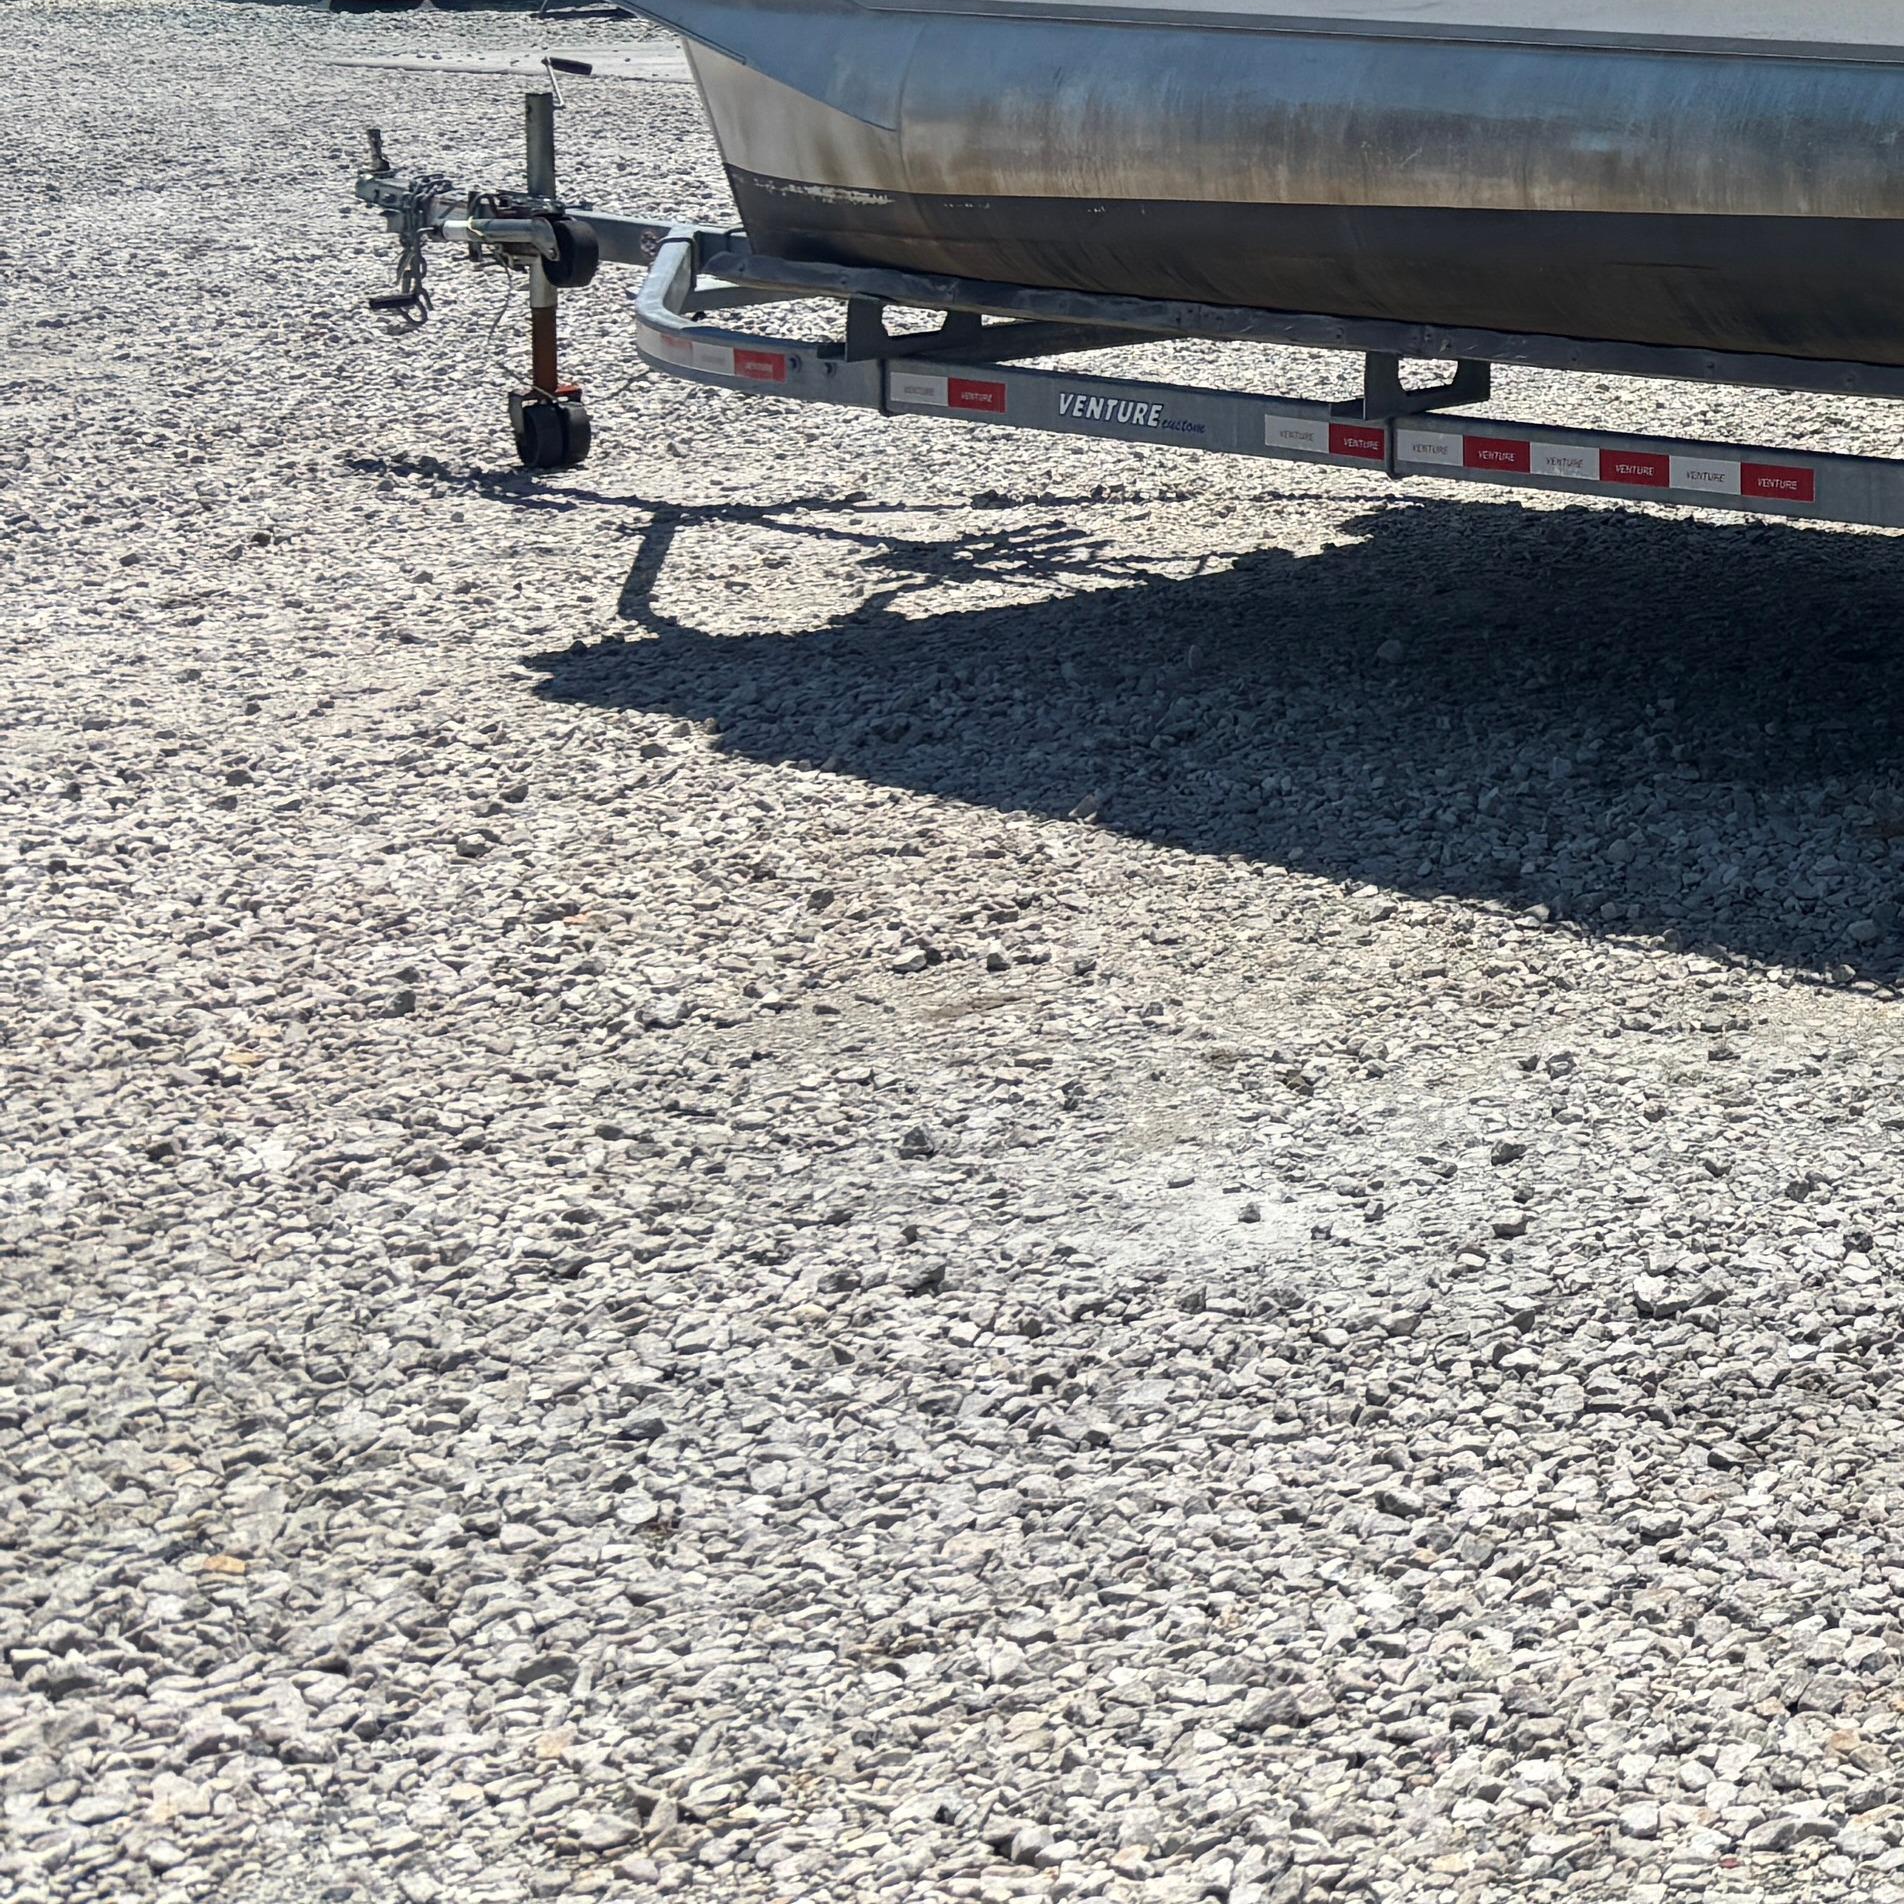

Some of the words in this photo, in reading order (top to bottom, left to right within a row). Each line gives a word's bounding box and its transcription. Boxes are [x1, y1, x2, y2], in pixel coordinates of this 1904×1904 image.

[1058, 393, 1163, 427] VENTURE
[1343, 438, 1380, 450] VENTURE
[1478, 450, 1516, 462] VENTURE
[1615, 464, 1655, 476] VENTURE
[1686, 471, 1726, 483] VENTURE
[1757, 478, 1798, 491] VENTURE
